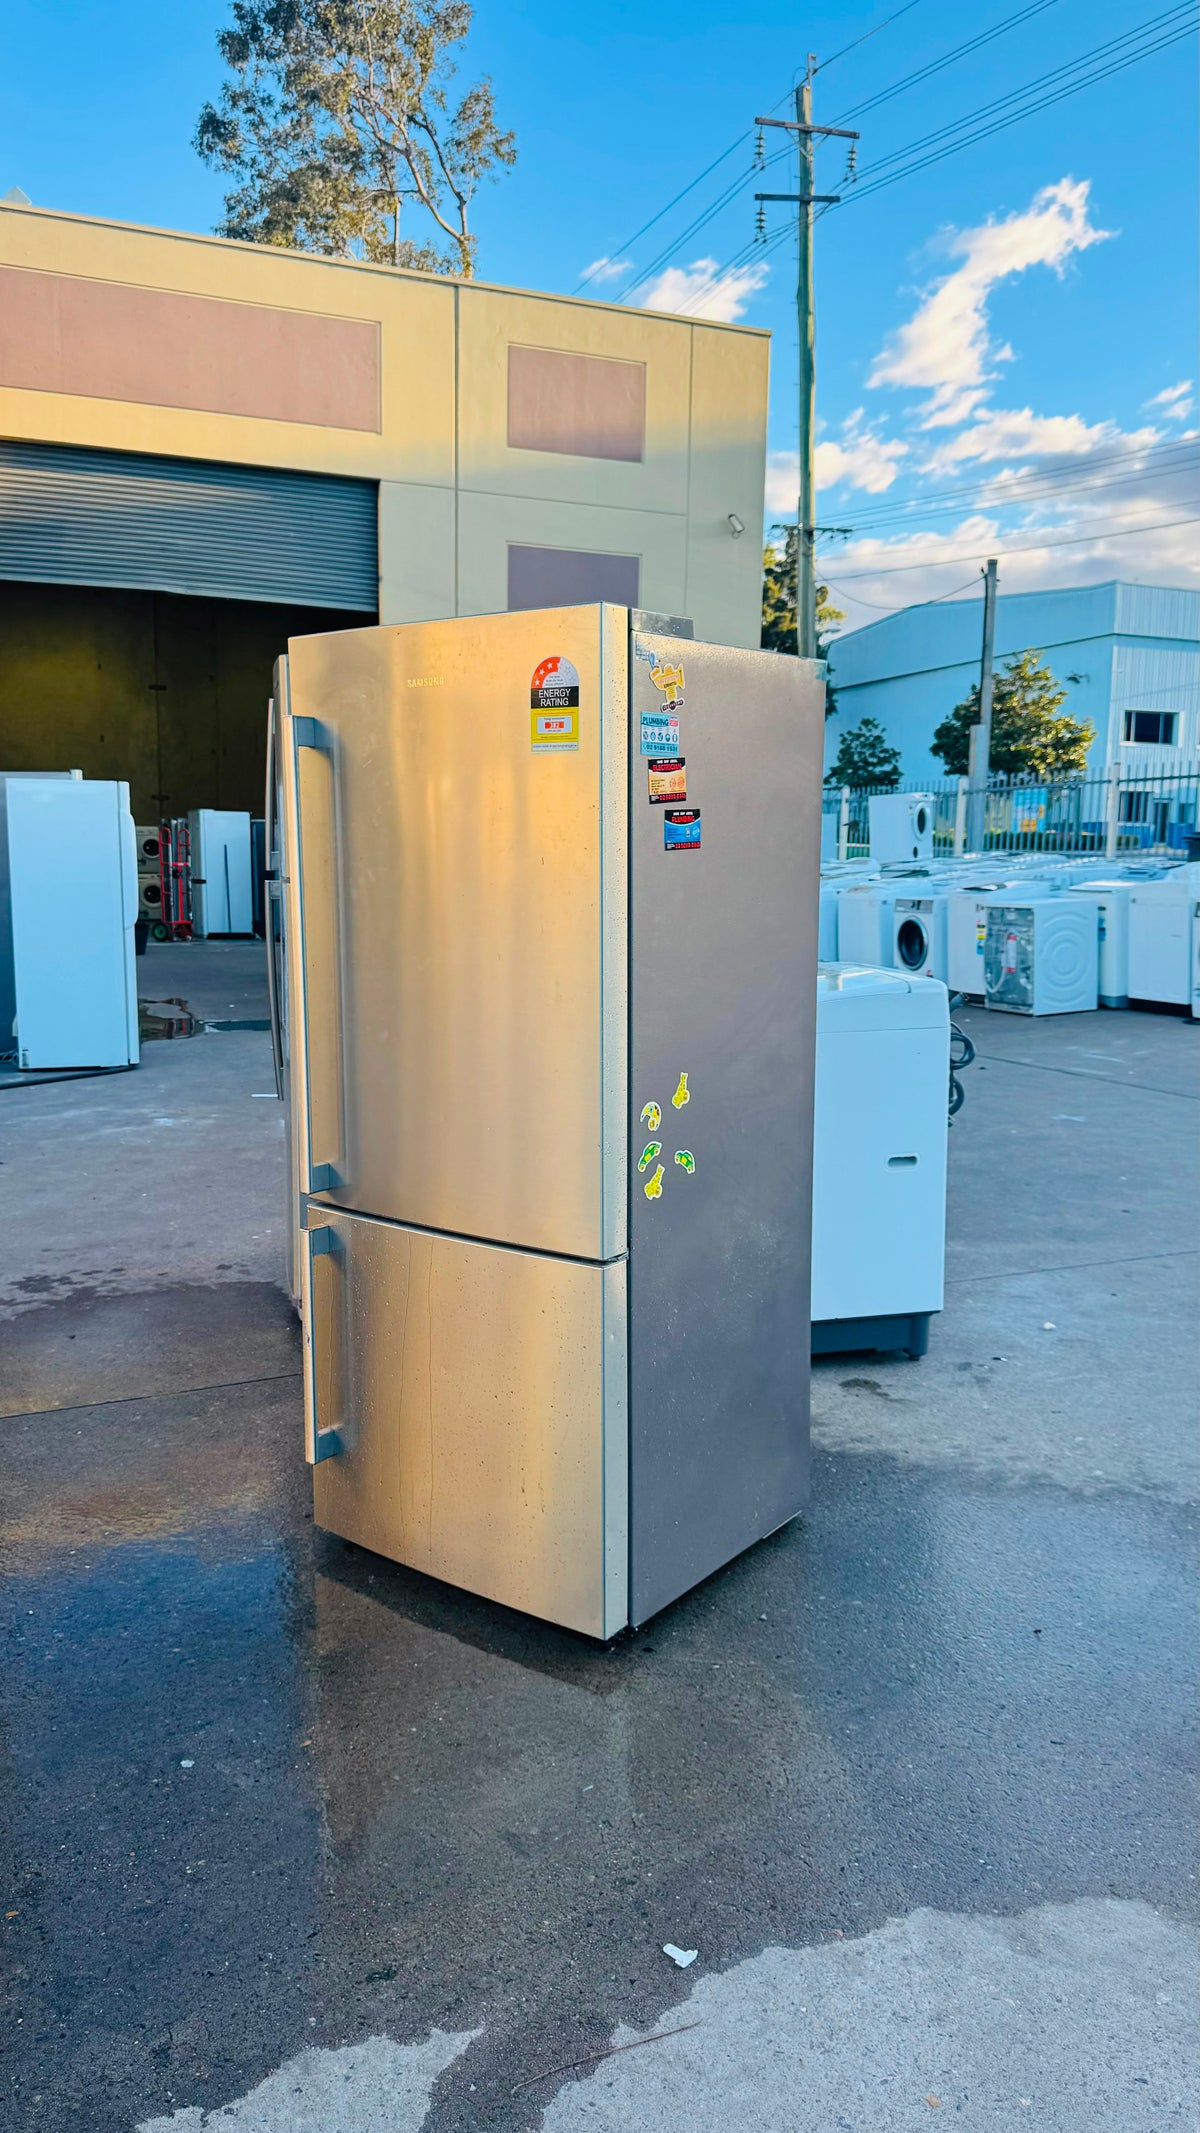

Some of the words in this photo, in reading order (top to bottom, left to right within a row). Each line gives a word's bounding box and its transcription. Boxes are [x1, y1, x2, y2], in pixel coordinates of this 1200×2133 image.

[538, 688, 571, 698] ENERGY
[540, 697, 569, 707] RATING
[643, 717, 668, 726] PLUMBING
